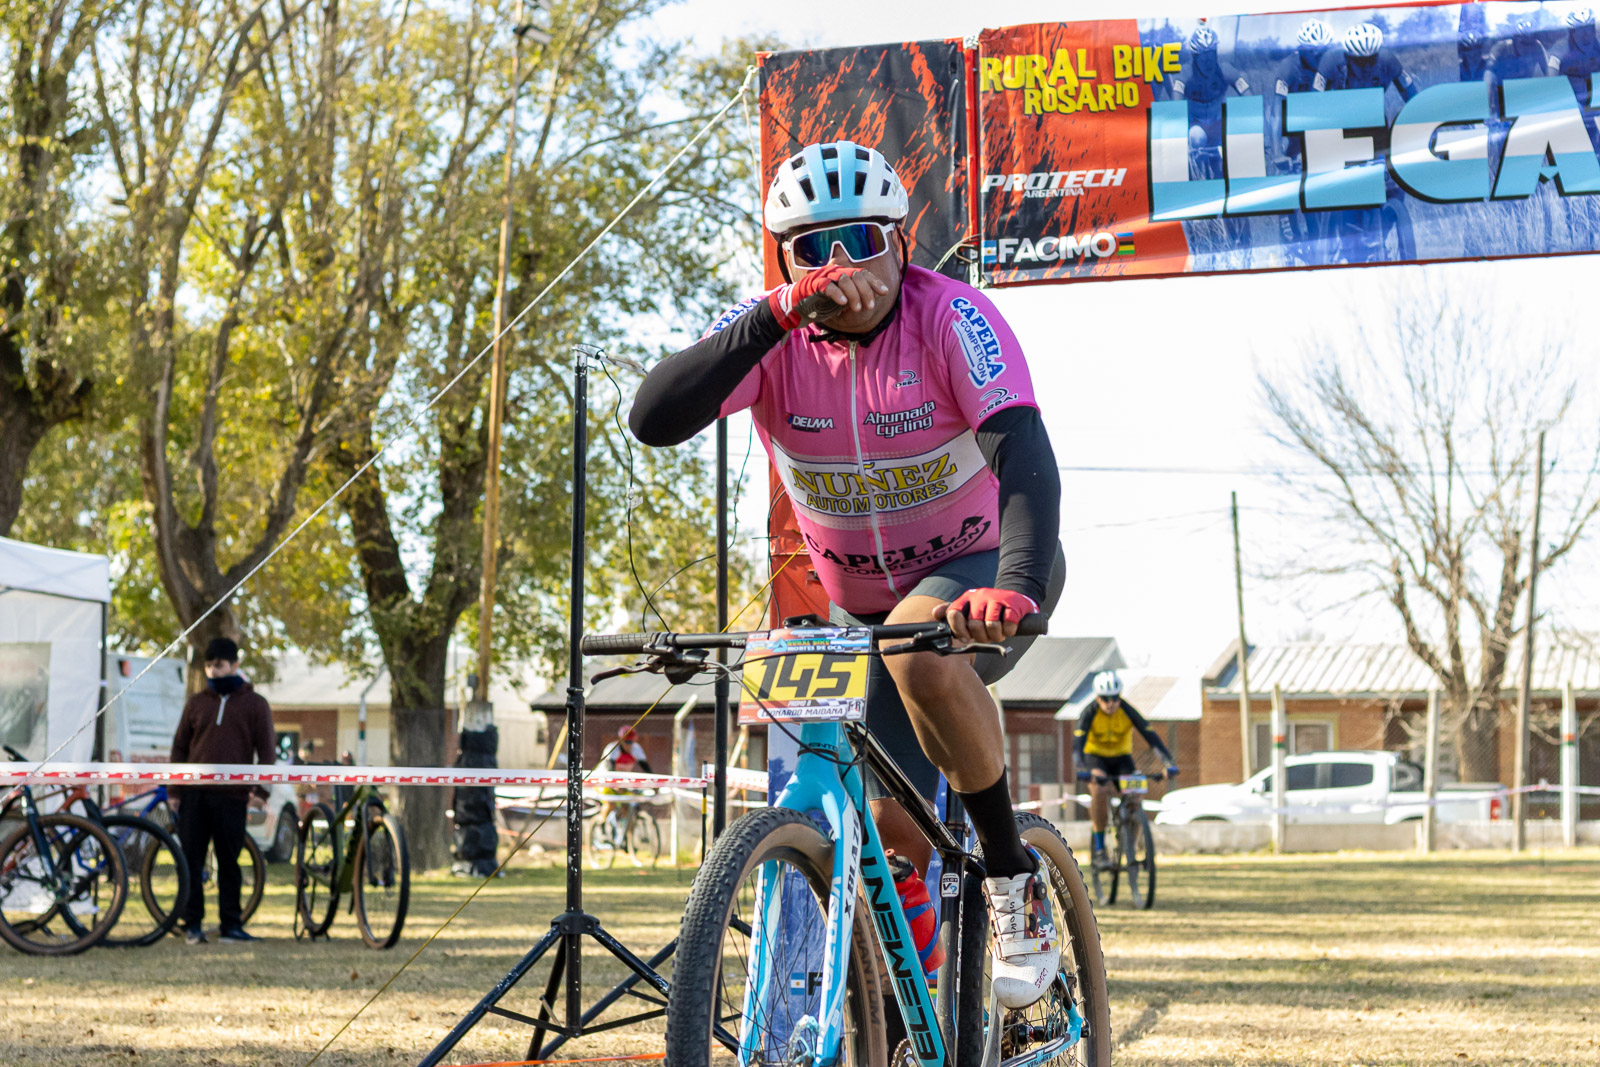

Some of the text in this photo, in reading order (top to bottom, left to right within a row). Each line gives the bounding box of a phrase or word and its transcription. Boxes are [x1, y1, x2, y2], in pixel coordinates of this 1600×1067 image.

[980, 42, 1183, 92] RURAL BIKE
[1024, 81, 1140, 115] ROSARIO
[1148, 72, 1600, 223] LLEGA
[980, 168, 1128, 193] PROTECH
[1022, 187, 1085, 199] ARGENTINA
[998, 232, 1117, 264] FACIMO
[792, 415, 834, 429] DELMA
[864, 400, 937, 425] Ahumada
[875, 415, 933, 438] Cycling
[788, 452, 958, 497] NUÑEZ
[807, 480, 949, 513] AUTOMOTORES
[805, 515, 985, 570] CAPELLA
[757, 654, 858, 699] 145
[761, 707, 843, 717] LEONARDO MAIDANA
